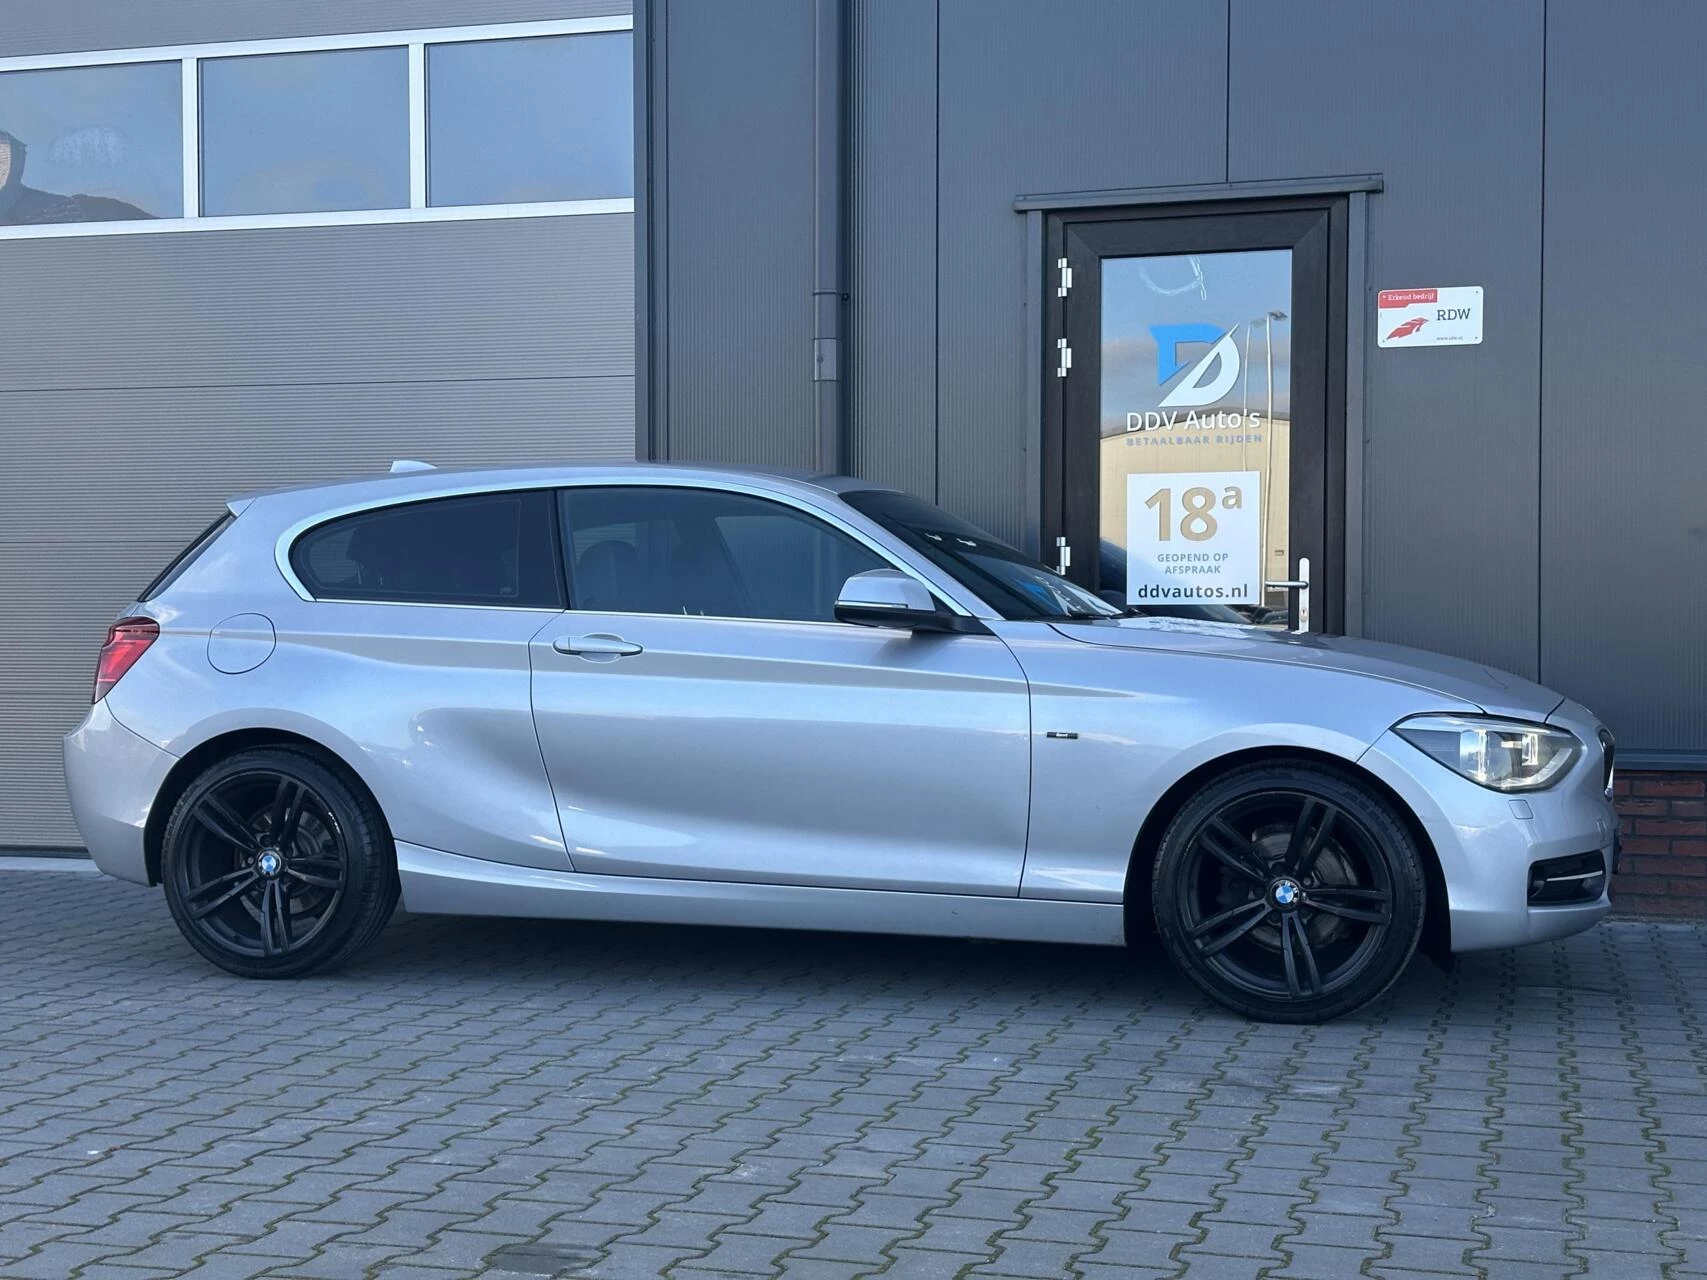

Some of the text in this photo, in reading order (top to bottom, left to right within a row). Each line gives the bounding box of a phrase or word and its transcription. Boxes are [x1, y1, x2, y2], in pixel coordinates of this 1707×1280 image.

[1436, 308, 1471, 321] RDW
[1126, 408, 1261, 432] DDV Auto's
[1126, 433, 1262, 446] BETAALBAAR RIJDEN
[1157, 552, 1229, 563] GEOPEND OP
[1164, 565, 1221, 575] AFSPRAAK
[1138, 583, 1248, 598] ddvautos.nl
